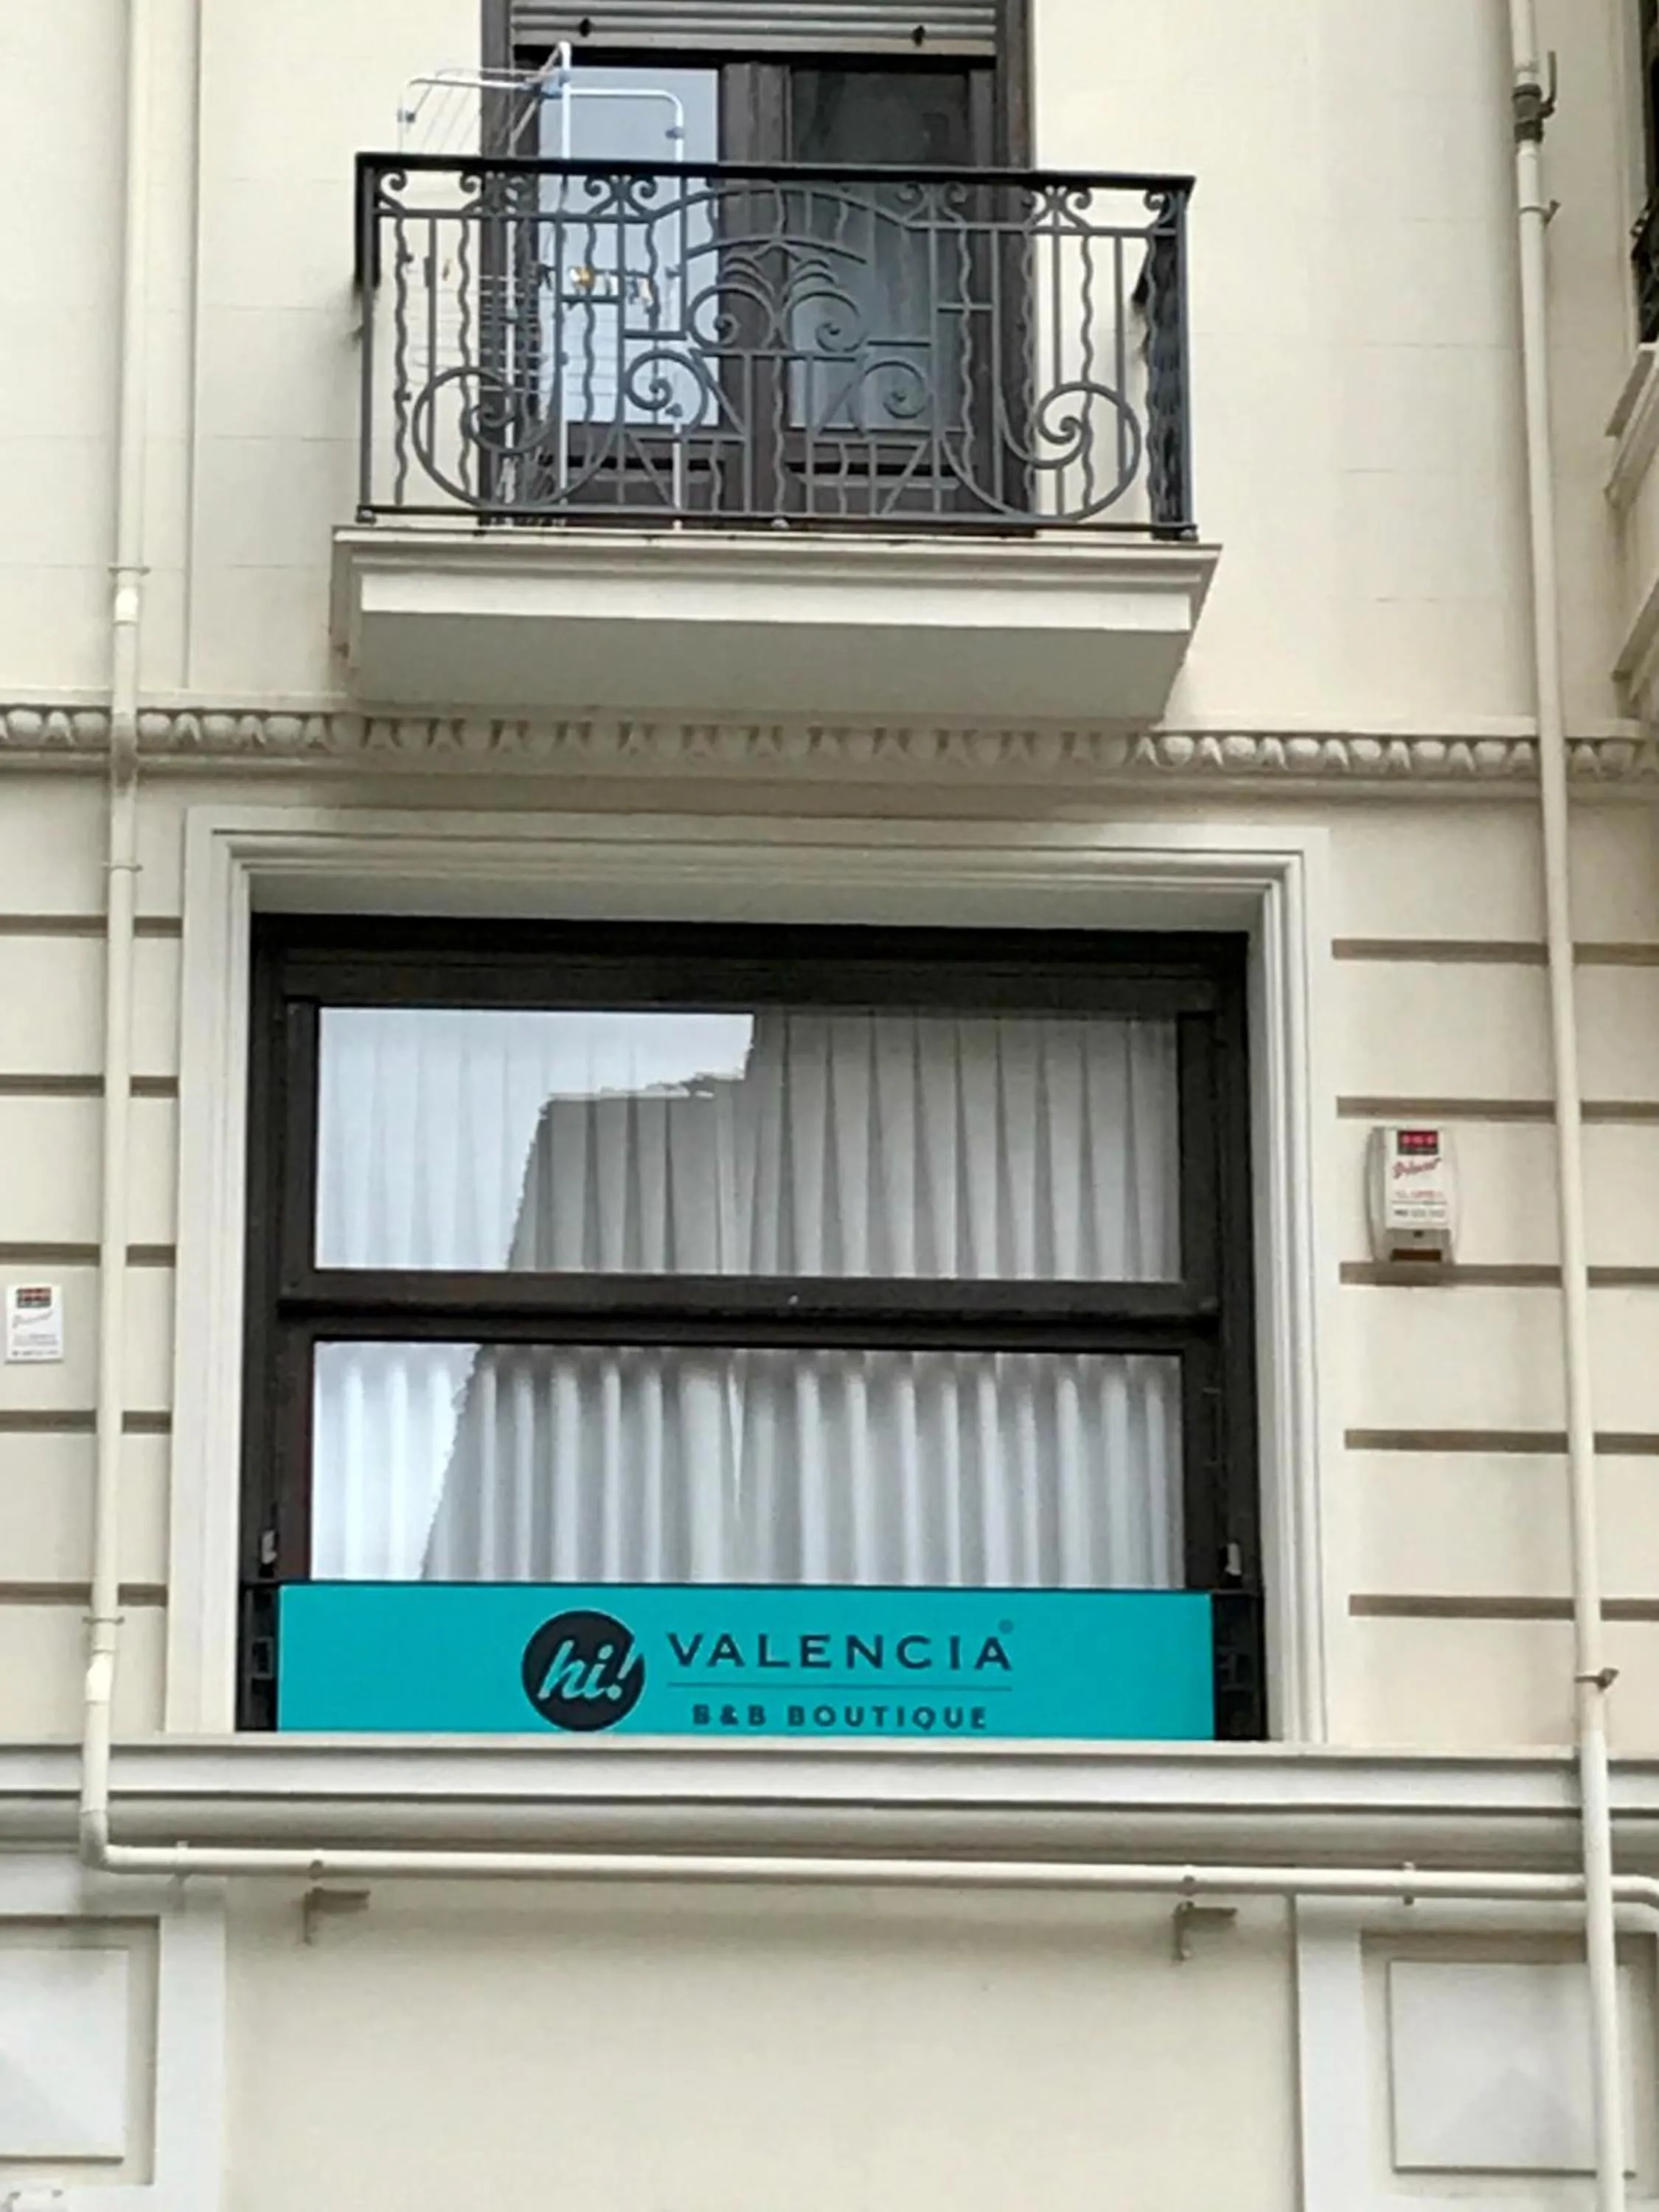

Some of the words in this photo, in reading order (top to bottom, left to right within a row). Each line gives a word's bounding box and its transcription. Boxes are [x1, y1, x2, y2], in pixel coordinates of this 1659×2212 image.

[538, 1639, 638, 1701] hi!
[667, 1632, 1012, 1671] VALENCIA
[692, 1704, 767, 1726] B&B
[787, 1705, 987, 1731] BOUTIQUE
